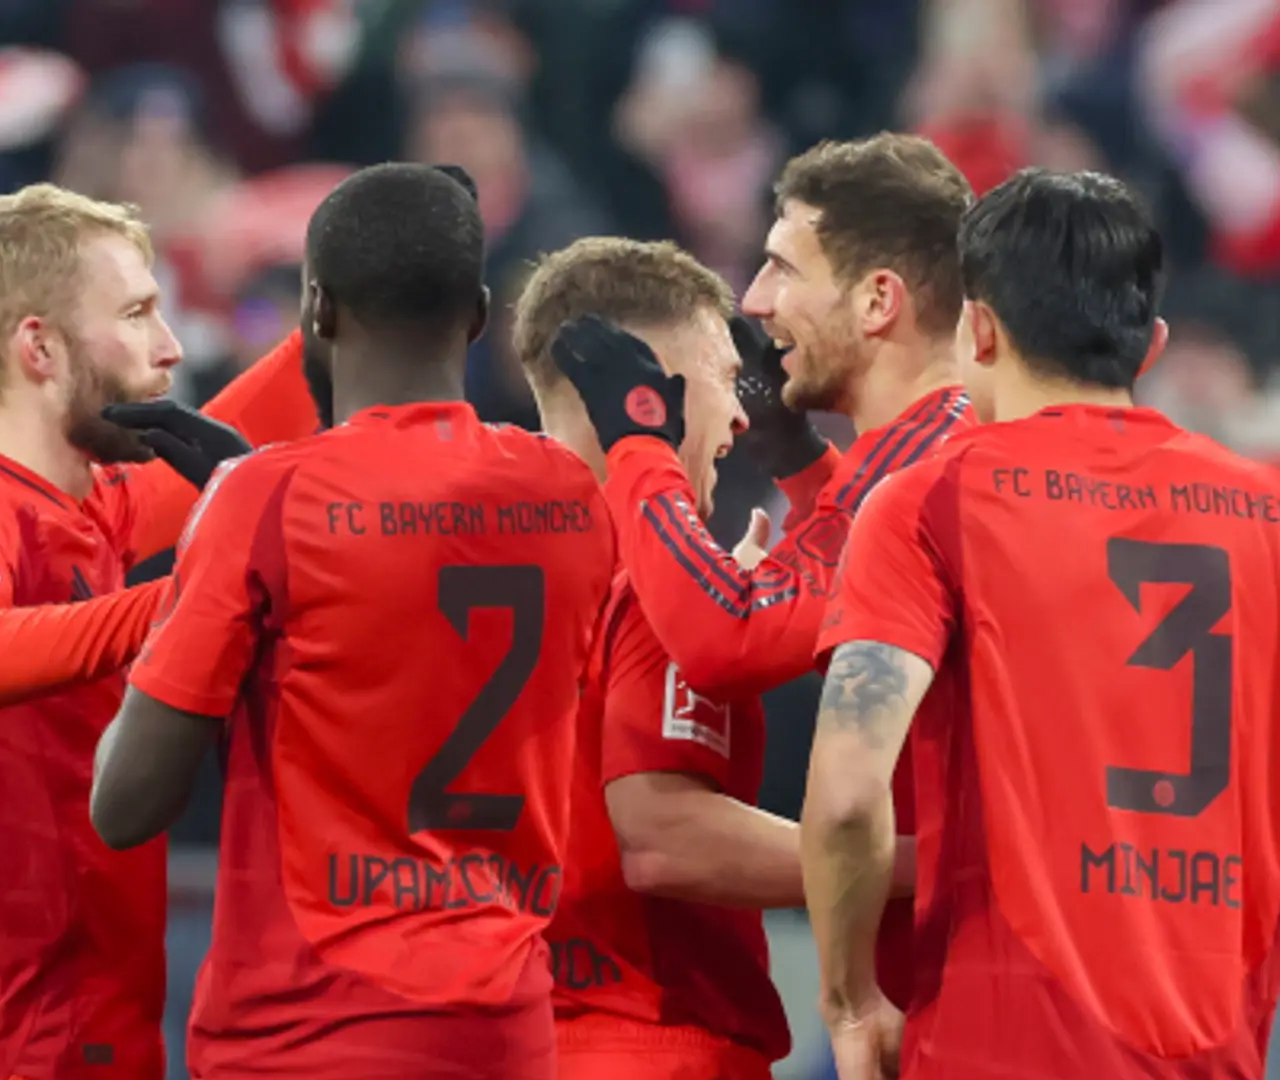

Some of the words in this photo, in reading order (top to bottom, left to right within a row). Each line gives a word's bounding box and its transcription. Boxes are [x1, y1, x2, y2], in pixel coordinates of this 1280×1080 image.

[326, 502, 367, 535] FC
[379, 502, 487, 536] BAYERN
[992, 467, 1031, 497] FC
[1044, 469, 1158, 510] BAYERN
[406, 564, 546, 837] 2
[1106, 537, 1233, 817] 3
[1081, 840, 1243, 909] MINJAE
